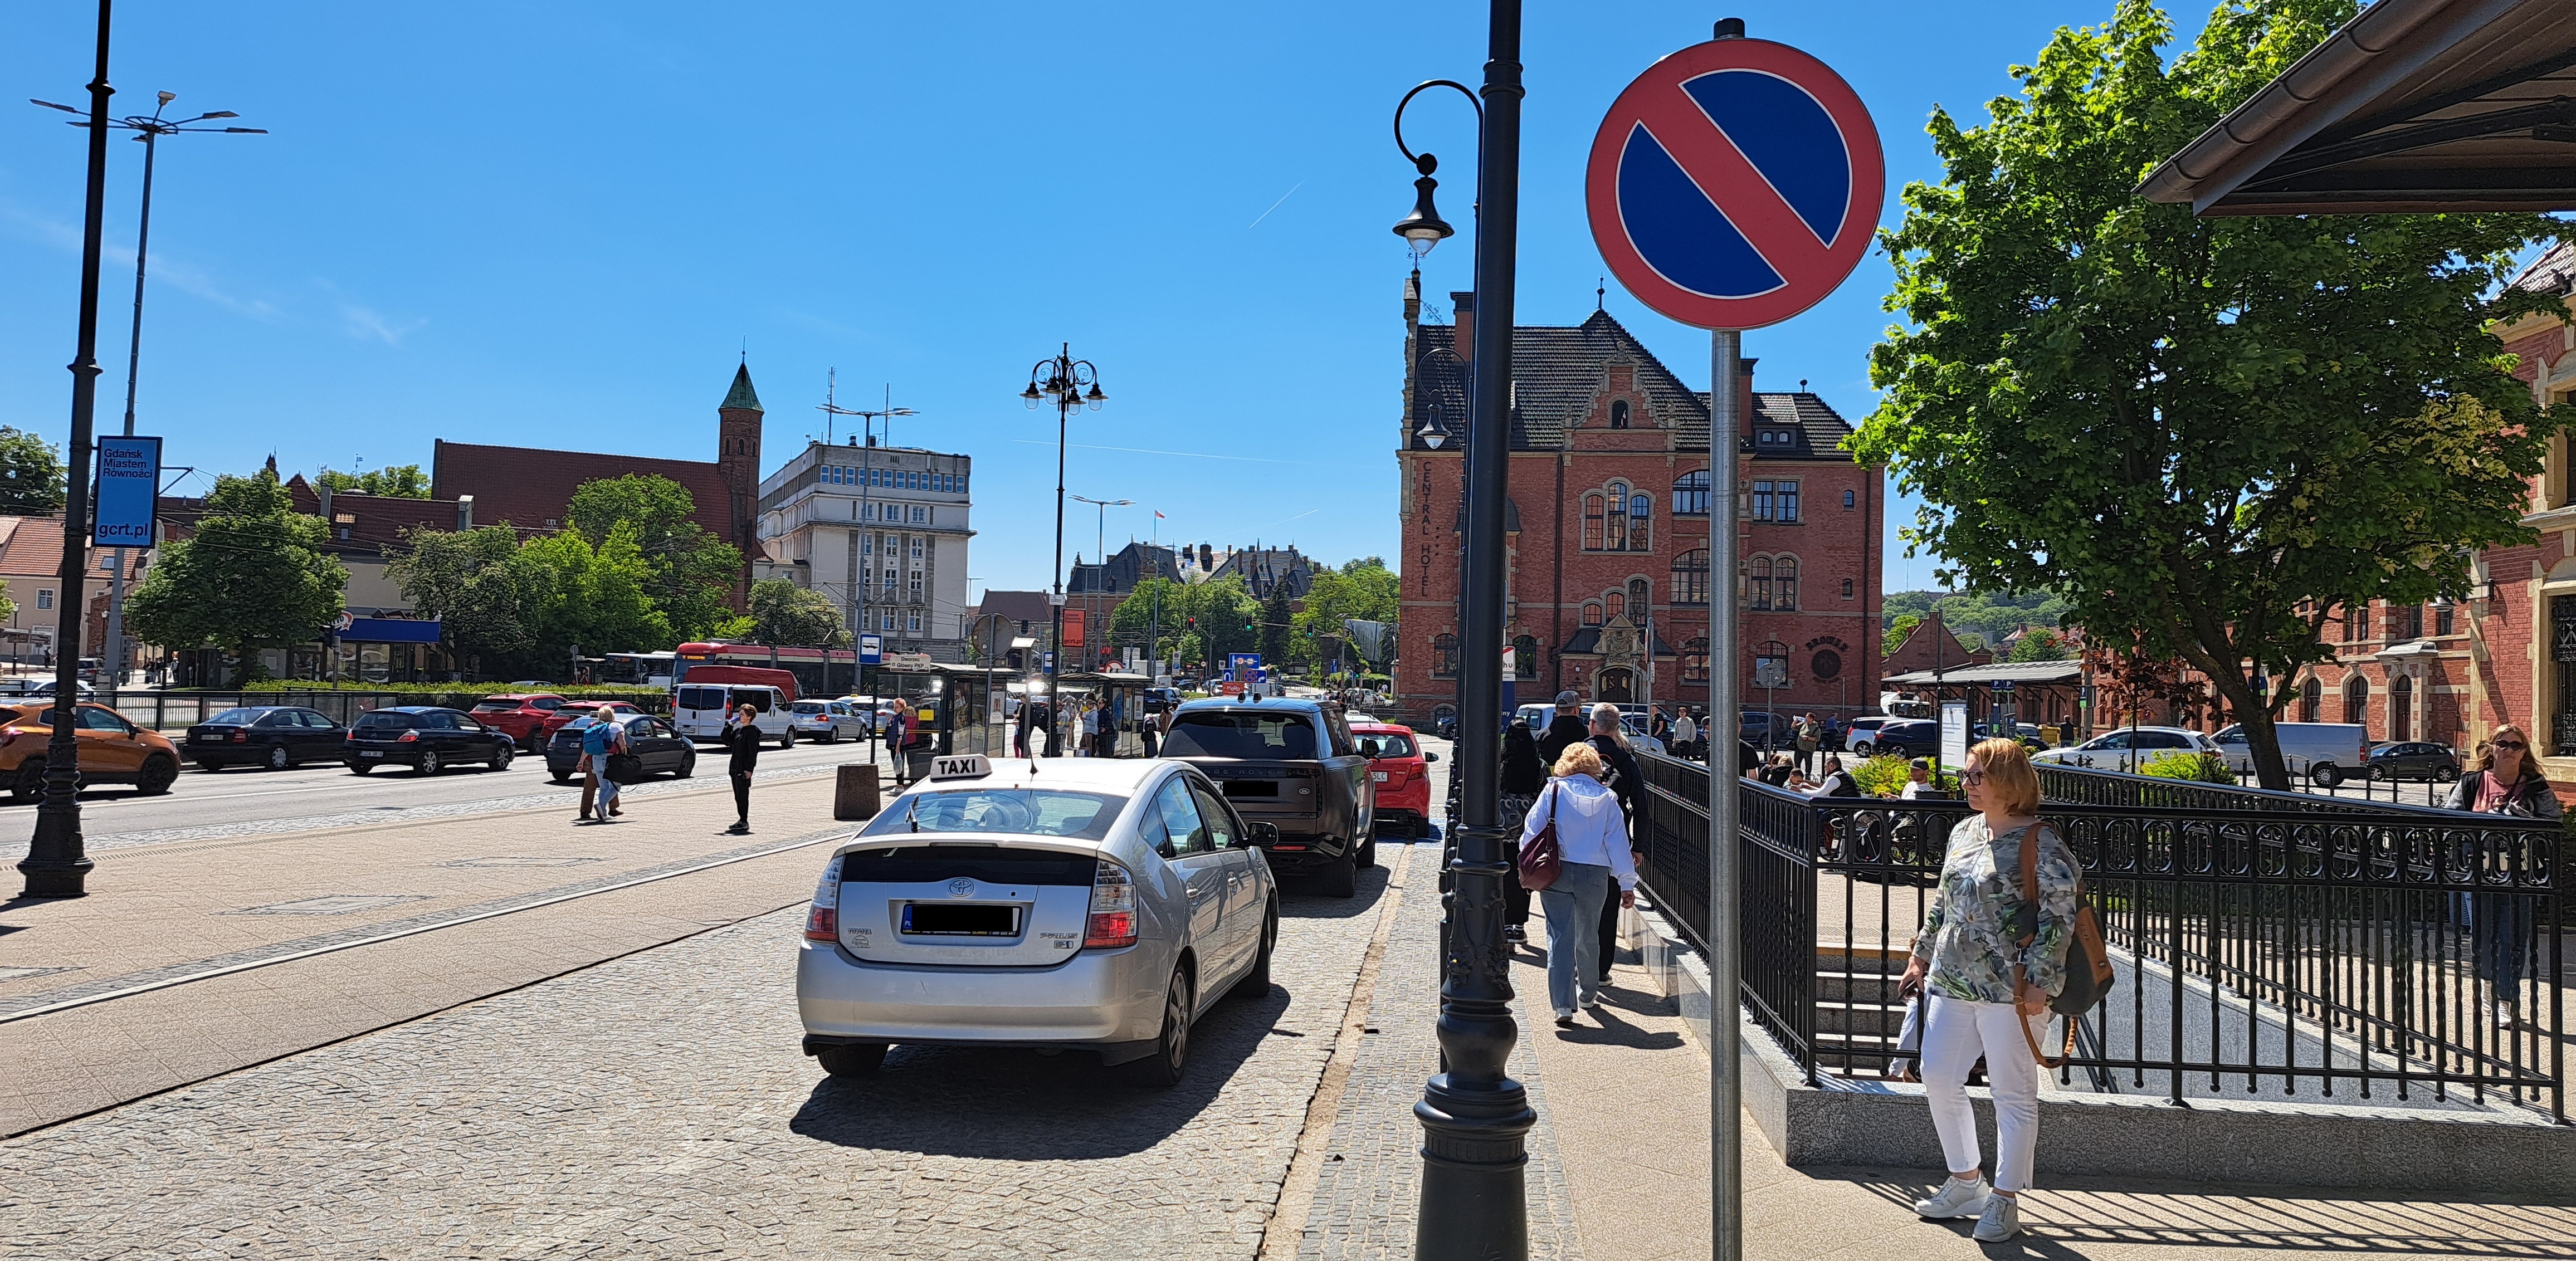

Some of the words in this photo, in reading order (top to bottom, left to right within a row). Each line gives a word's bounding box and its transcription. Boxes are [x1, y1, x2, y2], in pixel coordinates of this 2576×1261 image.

[104, 448, 143, 458] Gdańsk
[103, 458, 147, 468] Miastem
[103, 467, 153, 478] Równości
[1422, 461, 1432, 535] CENTRAL
[99, 522, 148, 539] gcrt.pl
[1421, 545, 1431, 597] HOTEL
[938, 759, 976, 775] TAXI
